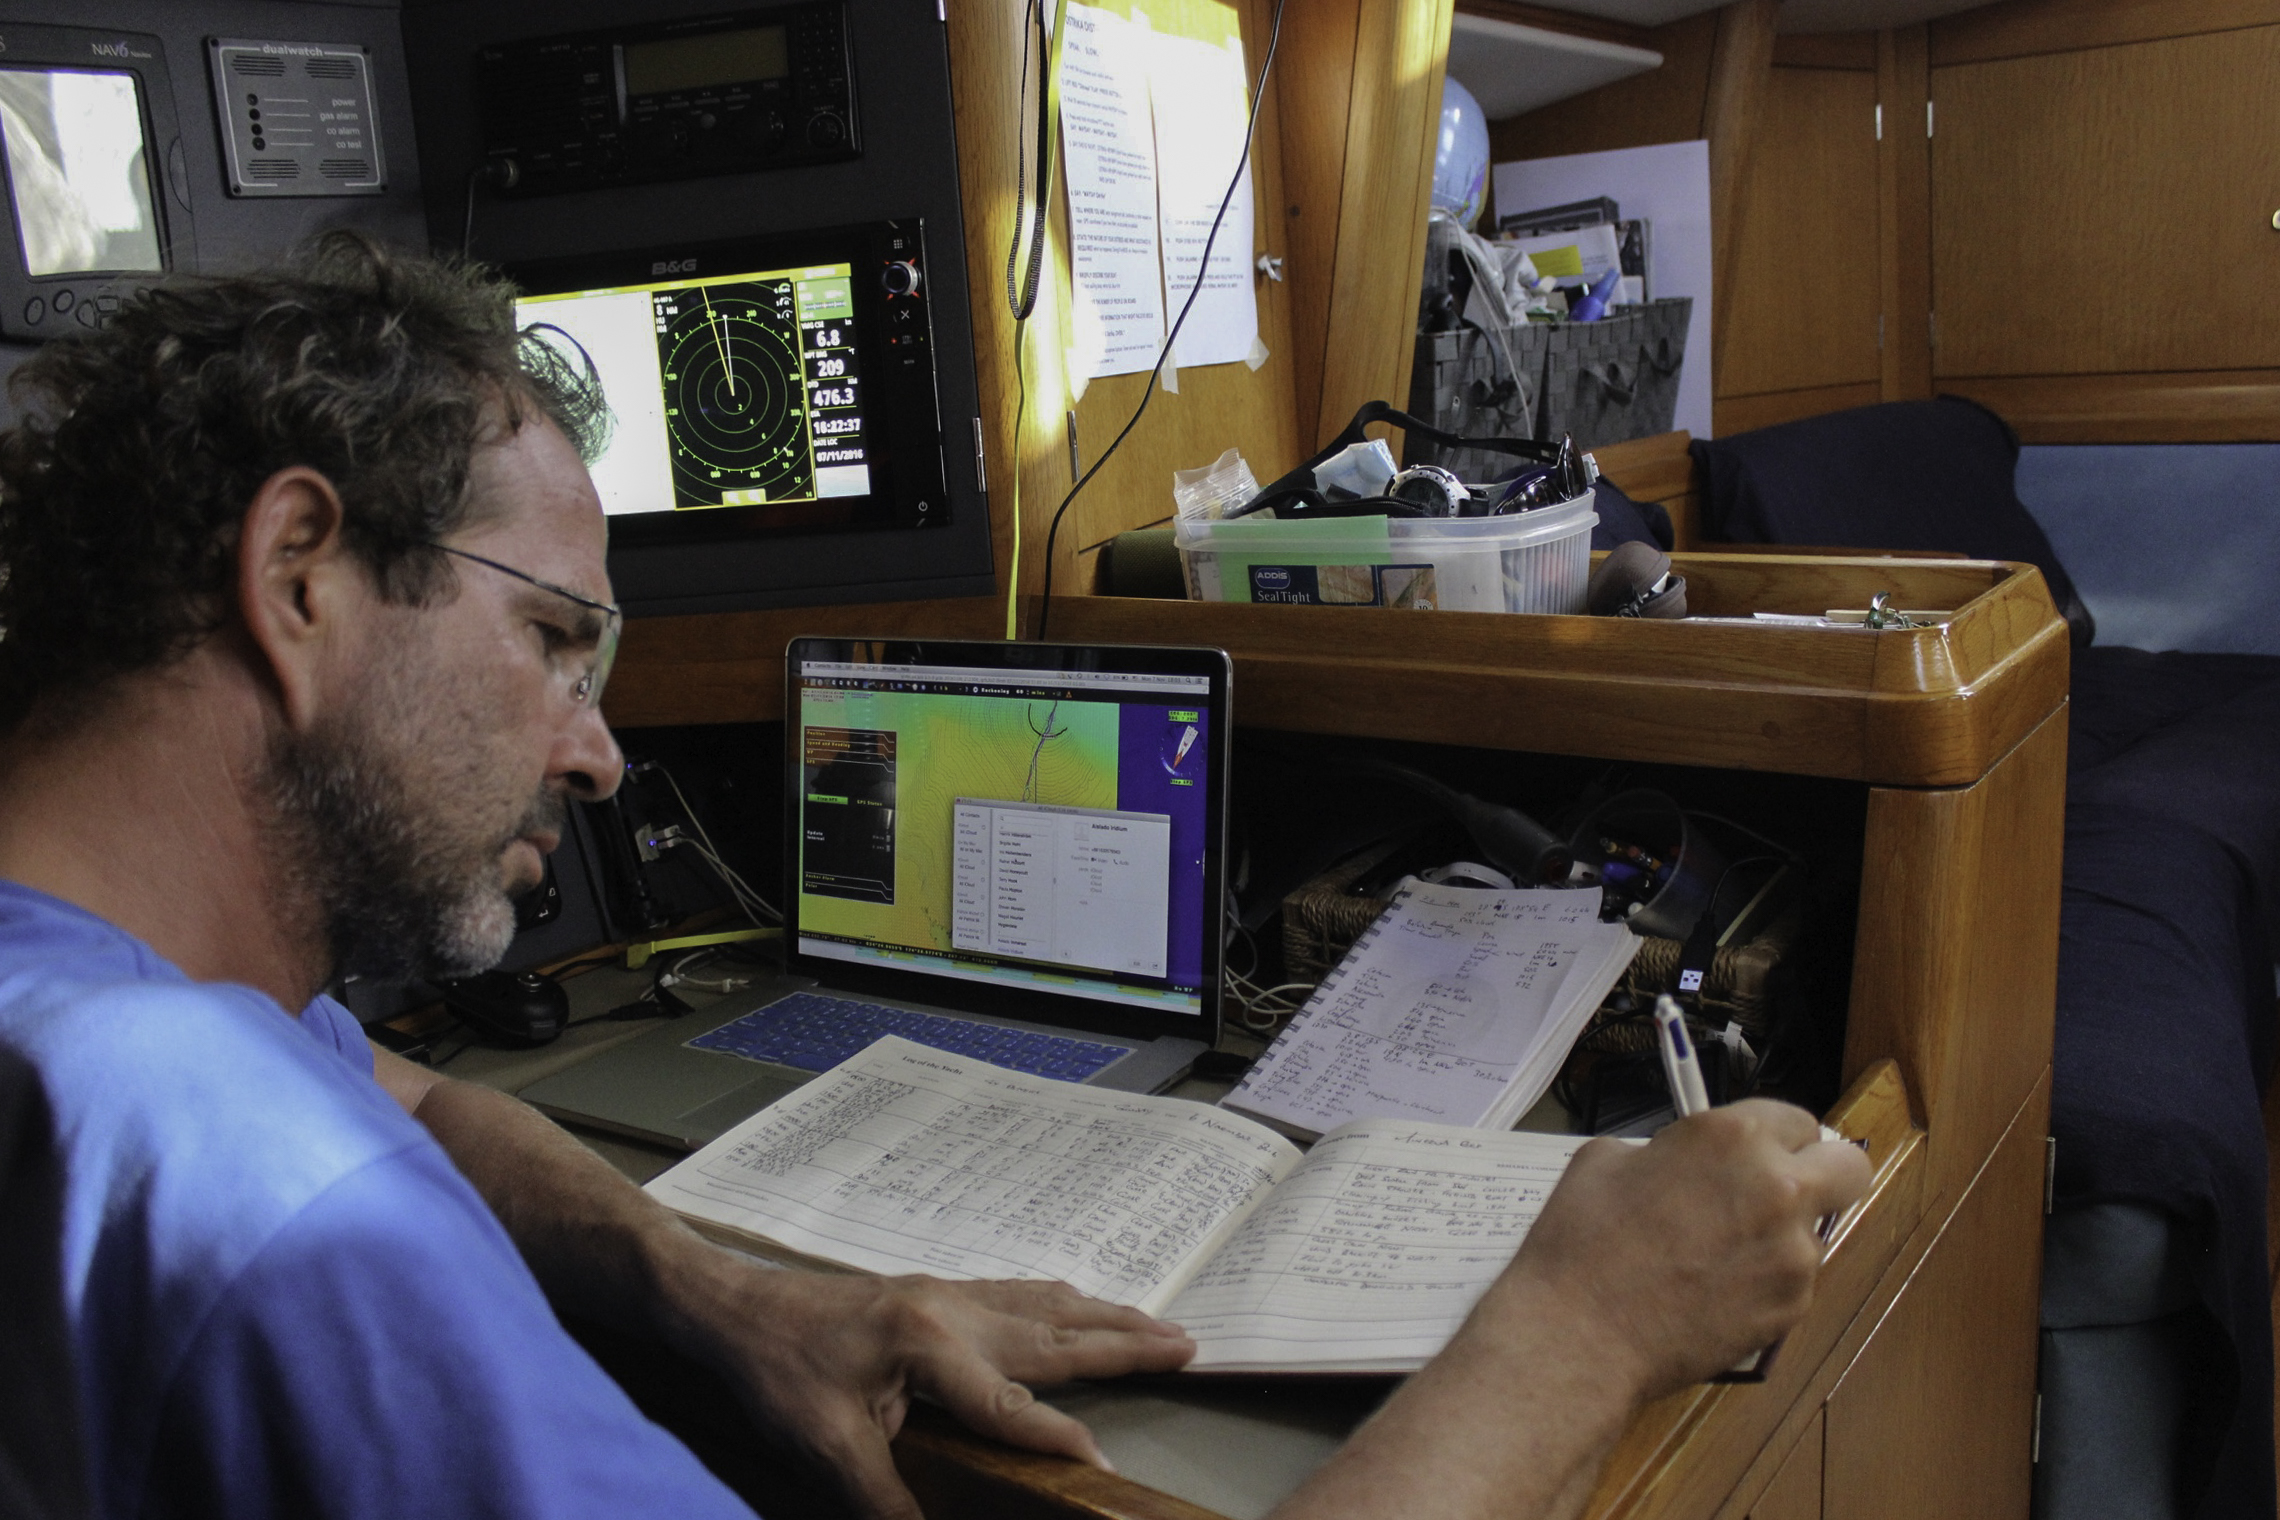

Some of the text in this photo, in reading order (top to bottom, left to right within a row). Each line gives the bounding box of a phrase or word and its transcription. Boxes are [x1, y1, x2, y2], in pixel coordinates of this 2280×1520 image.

[91, 42, 128, 58] NAV6
[262, 43, 324, 57] dualwatch
[331, 98, 356, 108] power
[319, 112, 359, 122] gas alarm
[326, 126, 361, 135] co alarm
[336, 141, 346, 149] co
[651, 258, 698, 276] B&G
[815, 328, 841, 348] 6.8
[817, 358, 846, 378] 209
[813, 387, 856, 407] 476.3
[816, 449, 864, 462] 07/11/2016
[1256, 570, 1288, 581] ADDIS
[902, 1055, 917, 1065] Log
[926, 1061, 939, 1070] the
[939, 1063, 963, 1075] Yacht
